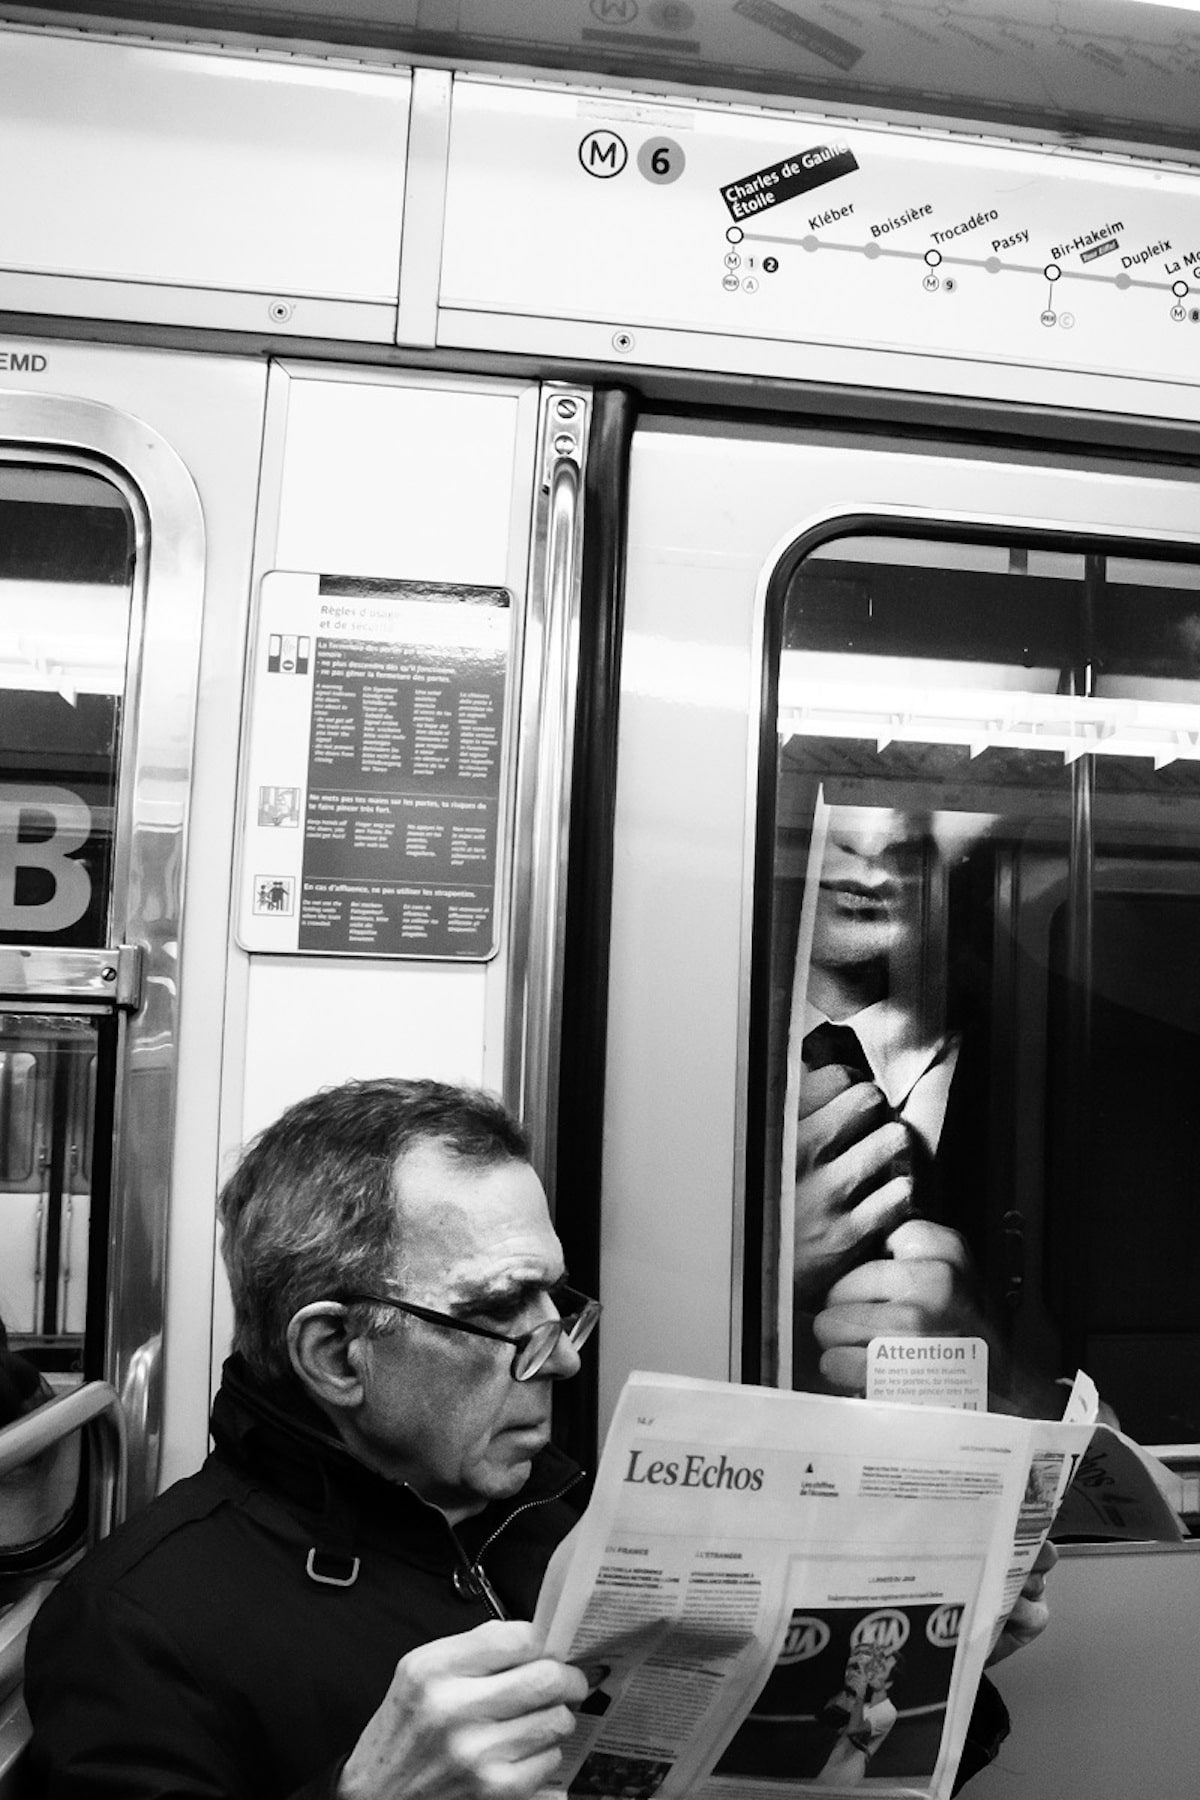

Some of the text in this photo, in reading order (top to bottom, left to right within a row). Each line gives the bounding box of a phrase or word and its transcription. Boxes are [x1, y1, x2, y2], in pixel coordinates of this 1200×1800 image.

[590, 139, 670, 176] M 6
[725, 171, 780, 202] Charles
[780, 162, 801, 179] de
[807, 203, 855, 231] Kléber
[870, 203, 934, 238] Boissière
[930, 208, 999, 245] Trocadéro
[990, 228, 1029, 253] Passy
[1050, 220, 1125, 260] Bir-Hakeim
[1120, 240, 1173, 269] Dupleix
[1164, 261, 1182, 275] La
[876, 1343, 965, 1360] Attention
[623, 1449, 765, 1492] Les Echos
